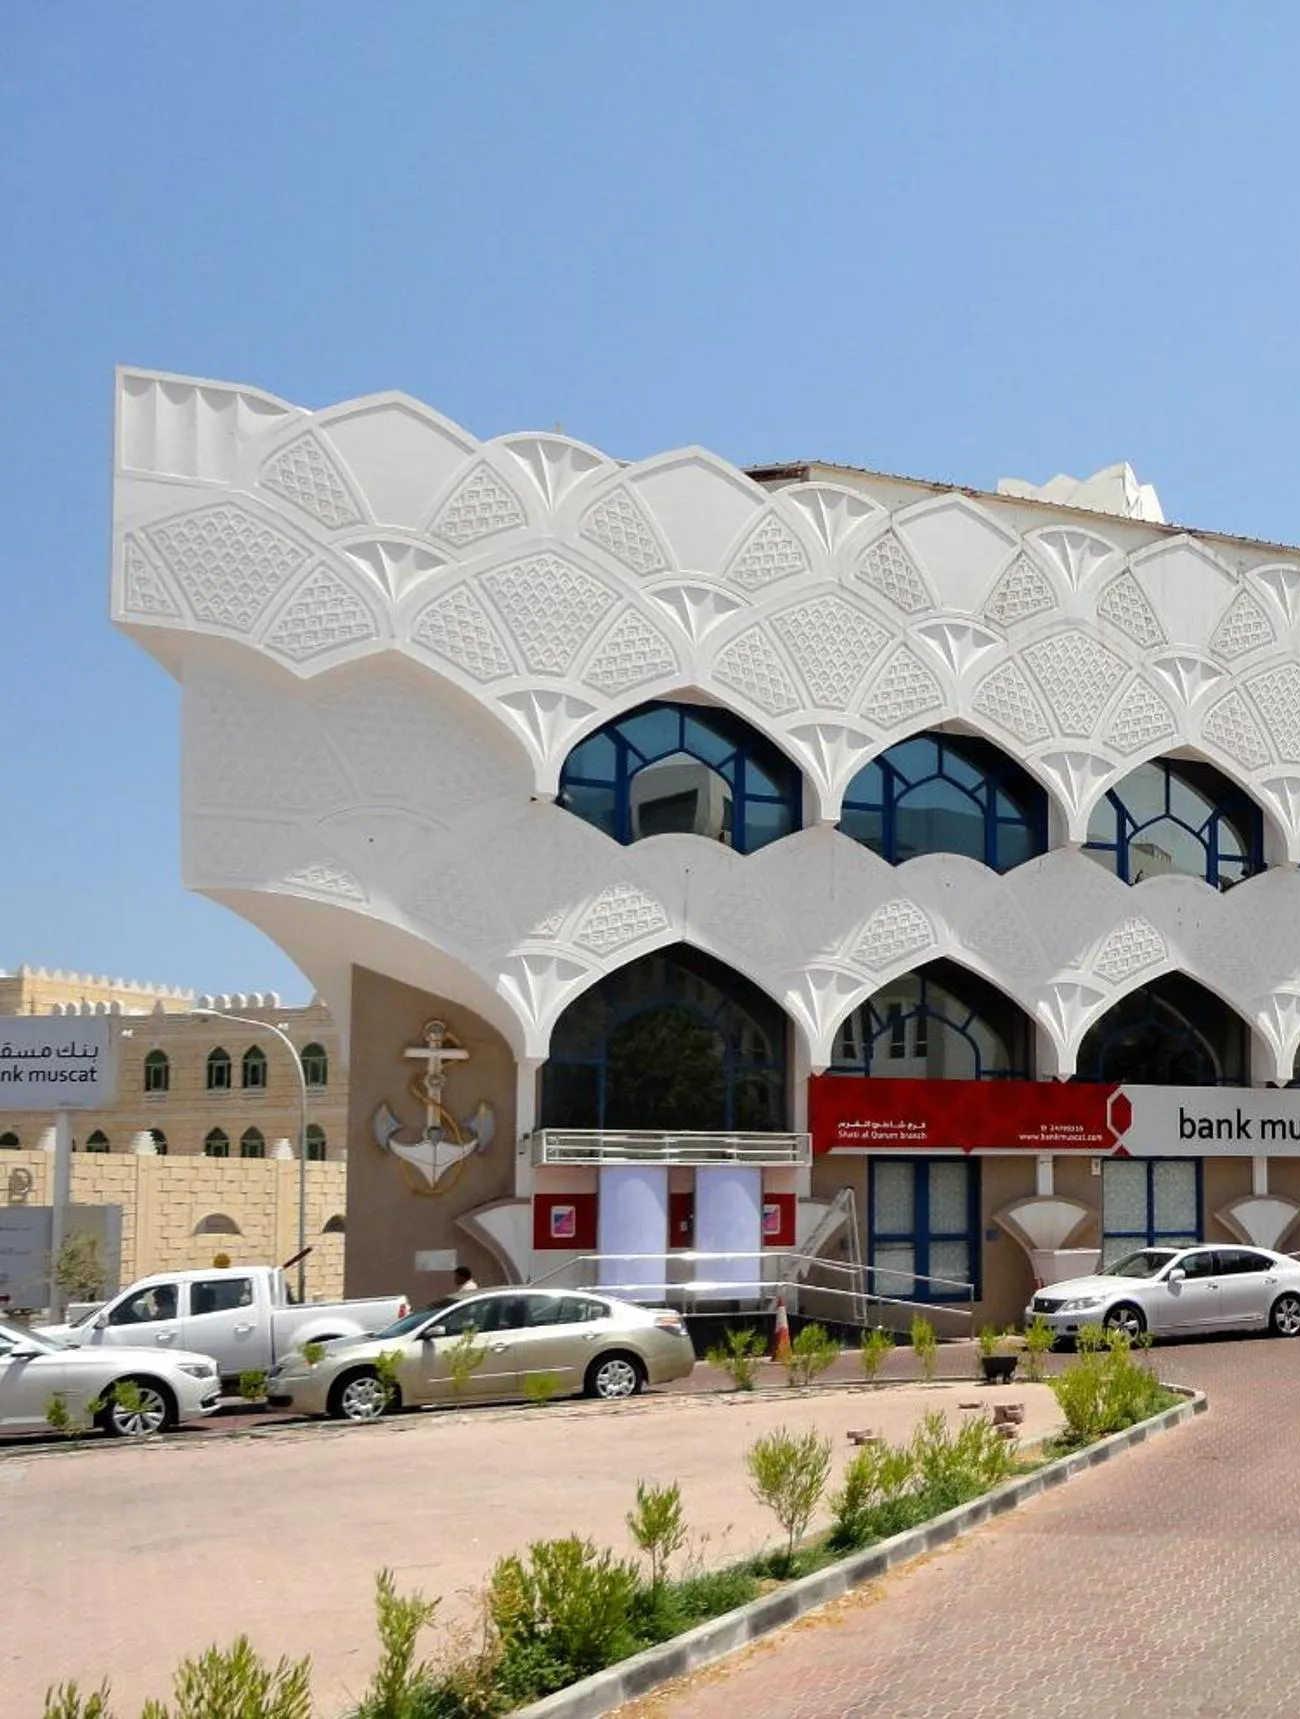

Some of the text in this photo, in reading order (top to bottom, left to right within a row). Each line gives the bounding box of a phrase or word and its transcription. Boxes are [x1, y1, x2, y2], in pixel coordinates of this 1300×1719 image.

[0, 1041, 99, 1064] بنك مسق
[0, 1064, 98, 1082] nk muscat
[1179, 1107, 1252, 1140] bank
